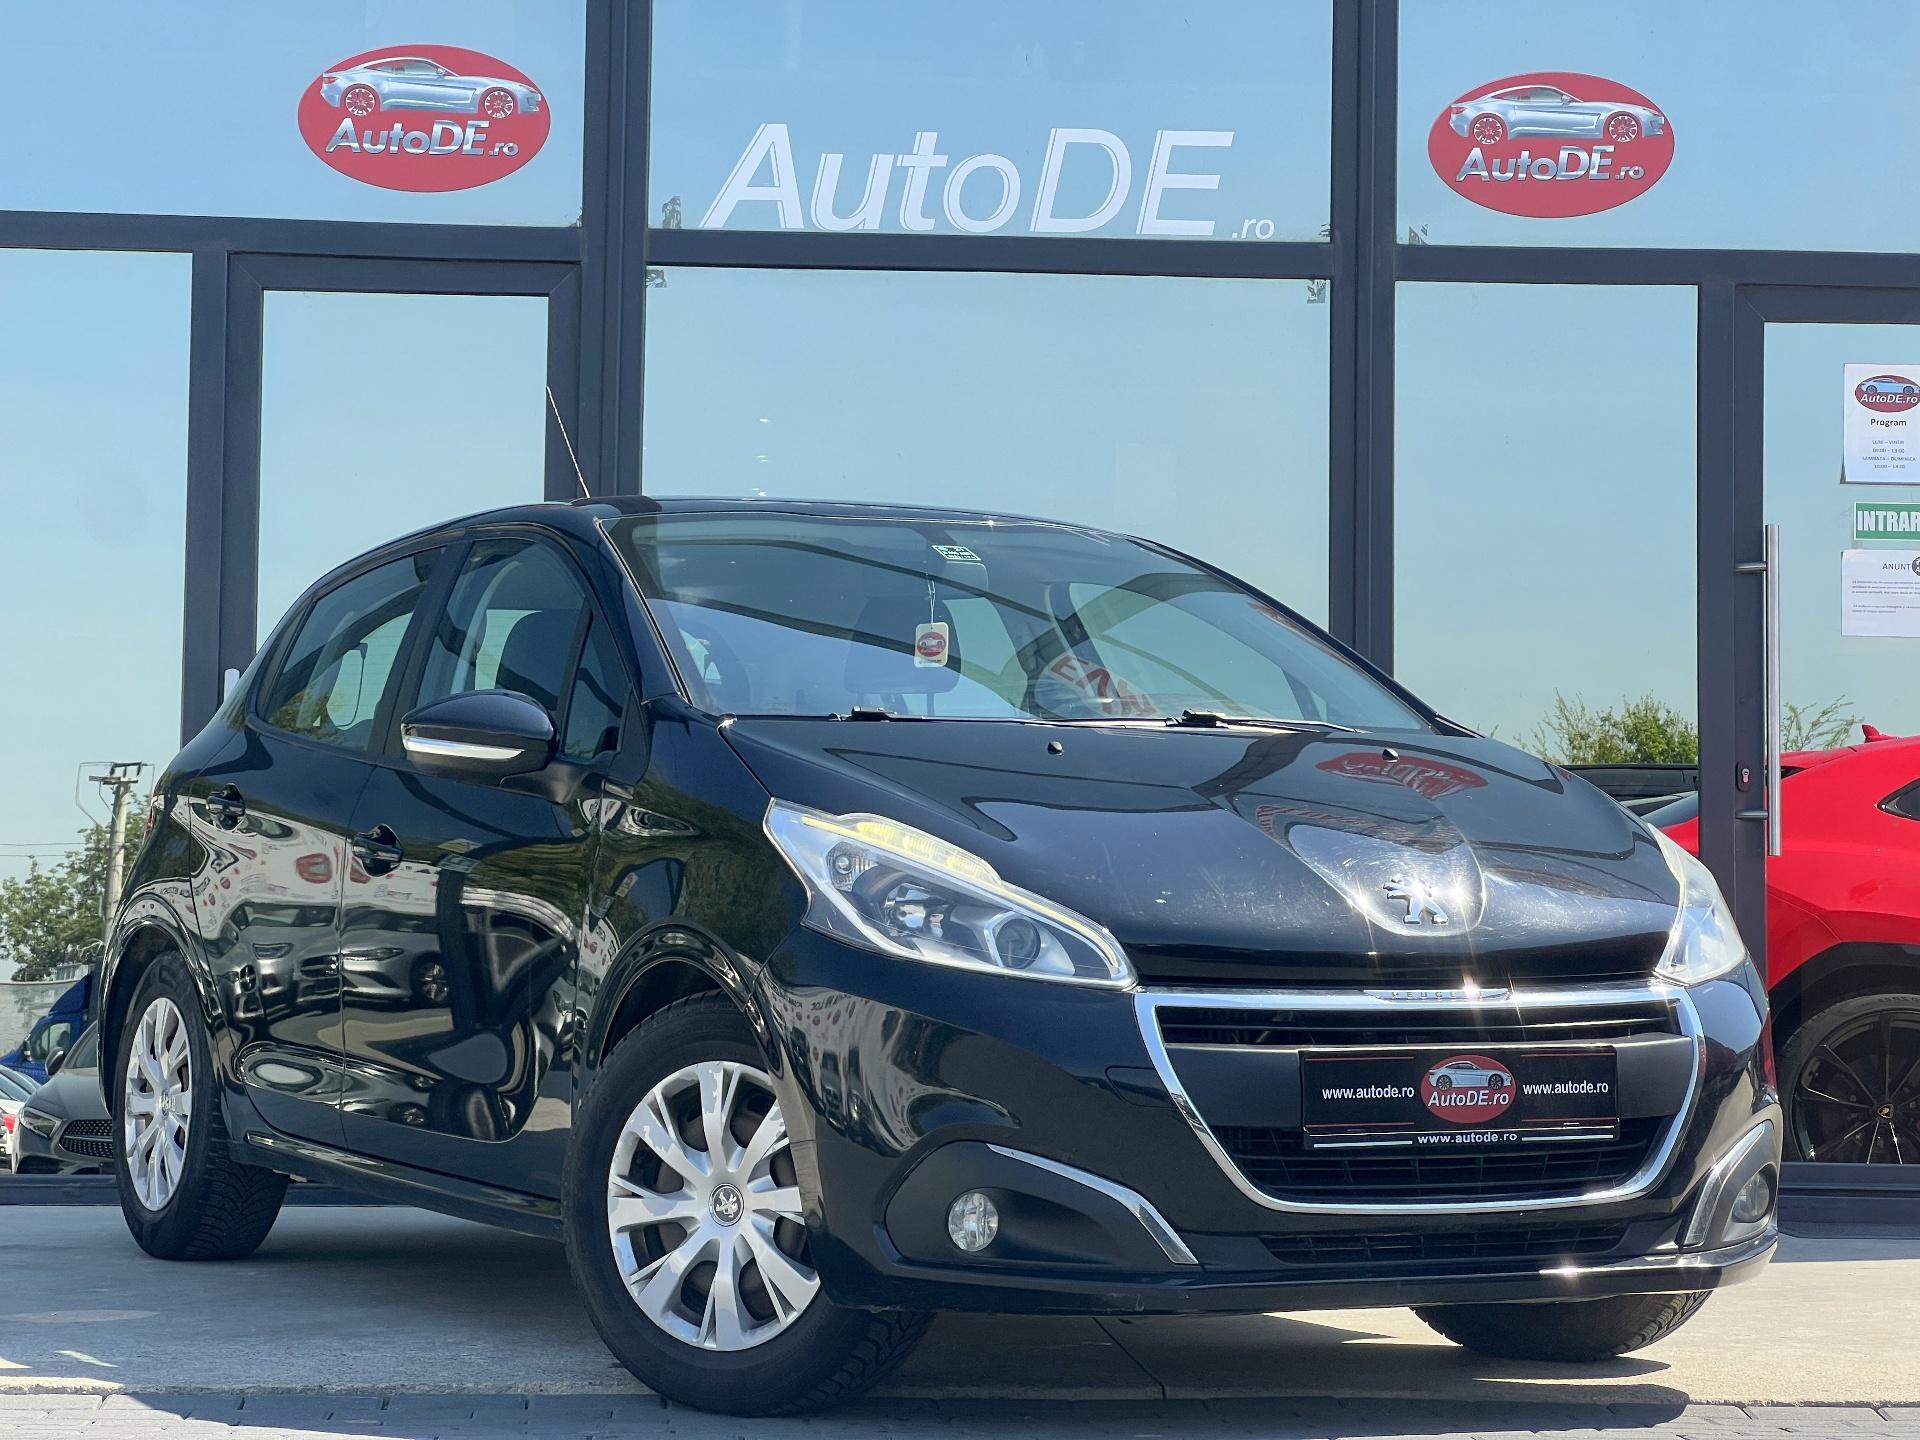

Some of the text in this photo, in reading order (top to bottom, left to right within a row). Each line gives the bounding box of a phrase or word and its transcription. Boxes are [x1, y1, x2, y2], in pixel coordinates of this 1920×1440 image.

[1860, 393, 1918, 404] AutoDE.ro
[1870, 418, 1907, 428] Program
[1321, 1084, 1415, 1100] www.autode.ro
[1522, 1081, 1609, 1096] www.autode.ro
[1427, 1090, 1510, 1107] AutoDE.ro
[1417, 1131, 1518, 1144] www.autode.ro
